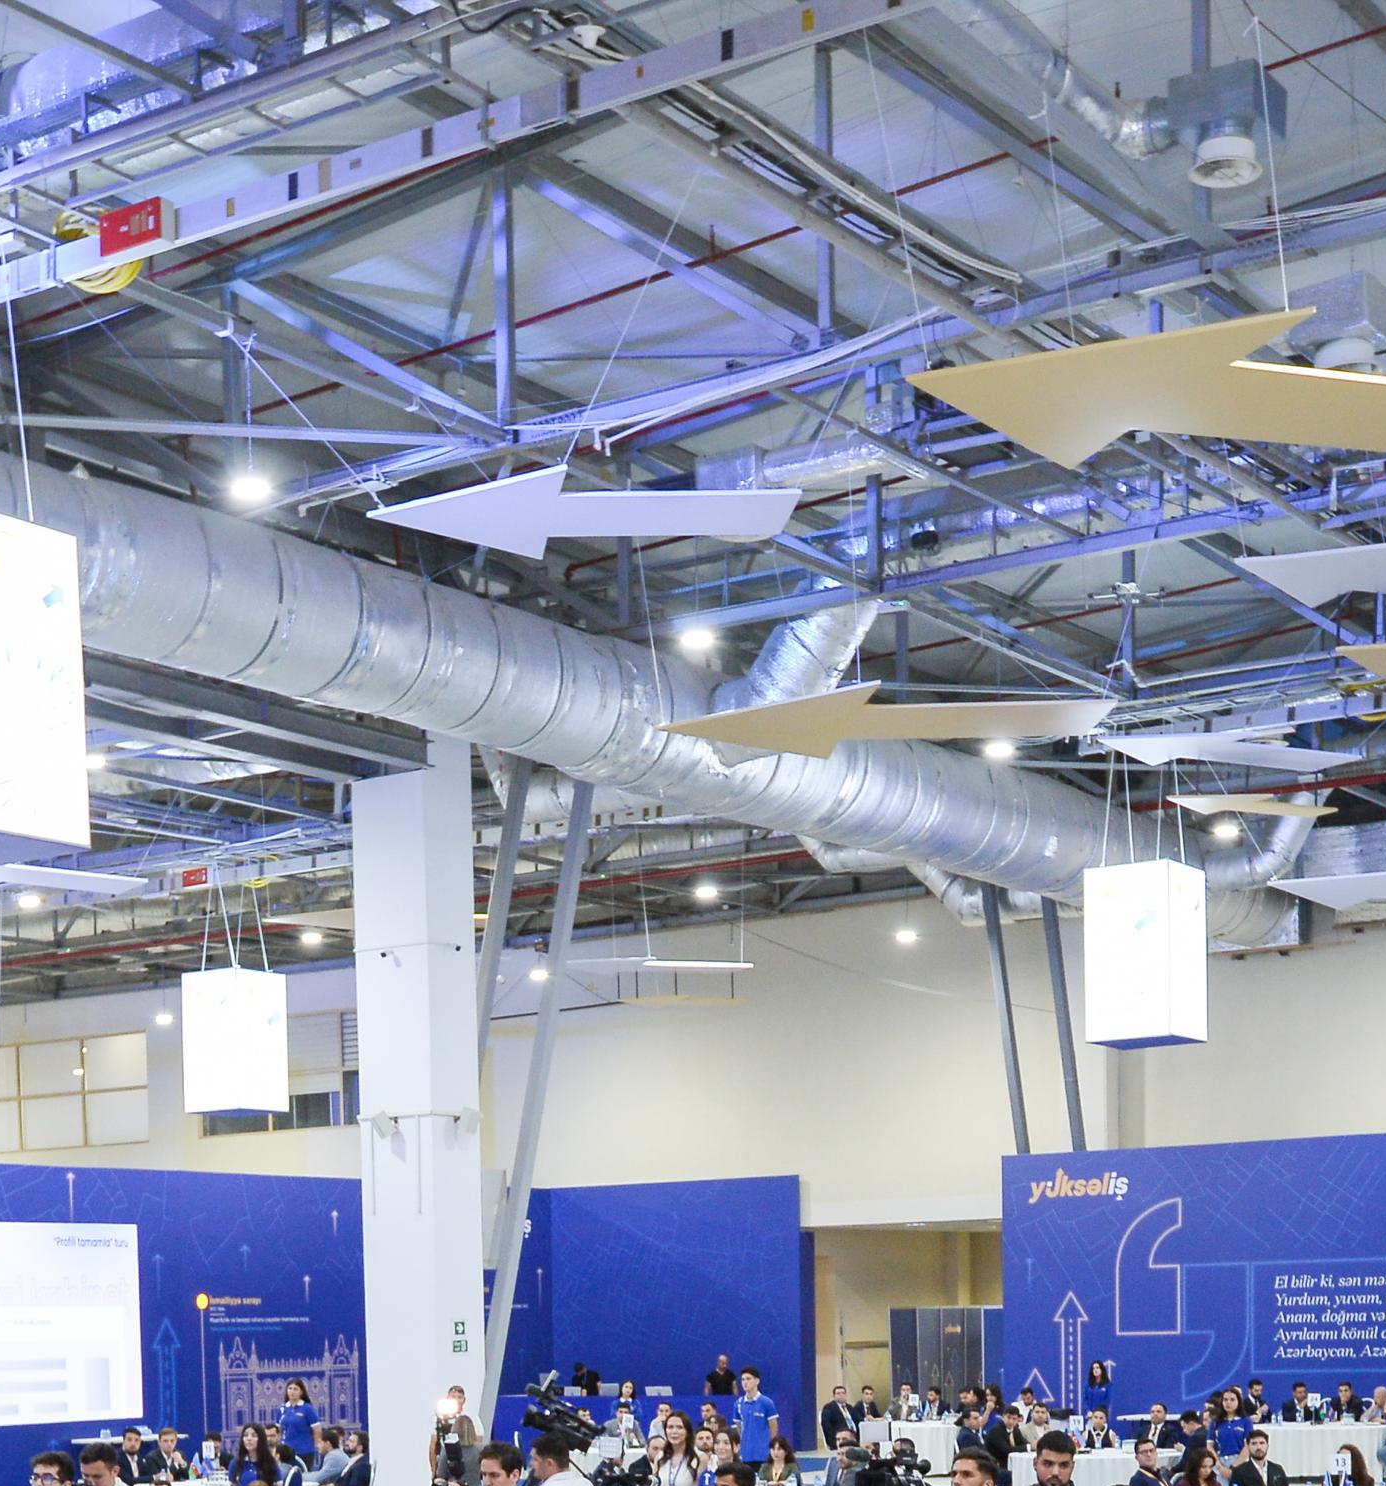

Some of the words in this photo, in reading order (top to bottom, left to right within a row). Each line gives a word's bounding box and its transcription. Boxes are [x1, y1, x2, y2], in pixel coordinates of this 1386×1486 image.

[1274, 1275, 1288, 1288] El
[1291, 1274, 1317, 1288] bilir
[1320, 1274, 1335, 1288] ki,
[1338, 1276, 1361, 1286] sən
[1276, 1292, 1331, 1306] Yurdum,
[1333, 1294, 1382, 1308] yuvam,
[1274, 1311, 1318, 1324] Anam,
[1322, 1309, 1367, 1325] doğma
[1274, 1327, 1337, 1344] Ayrılarmı
[1341, 1326, 1378, 1340] könül
[1274, 1344, 1356, 1360] Azərbaycan,
[1335, 1458, 1346, 1467] 13
